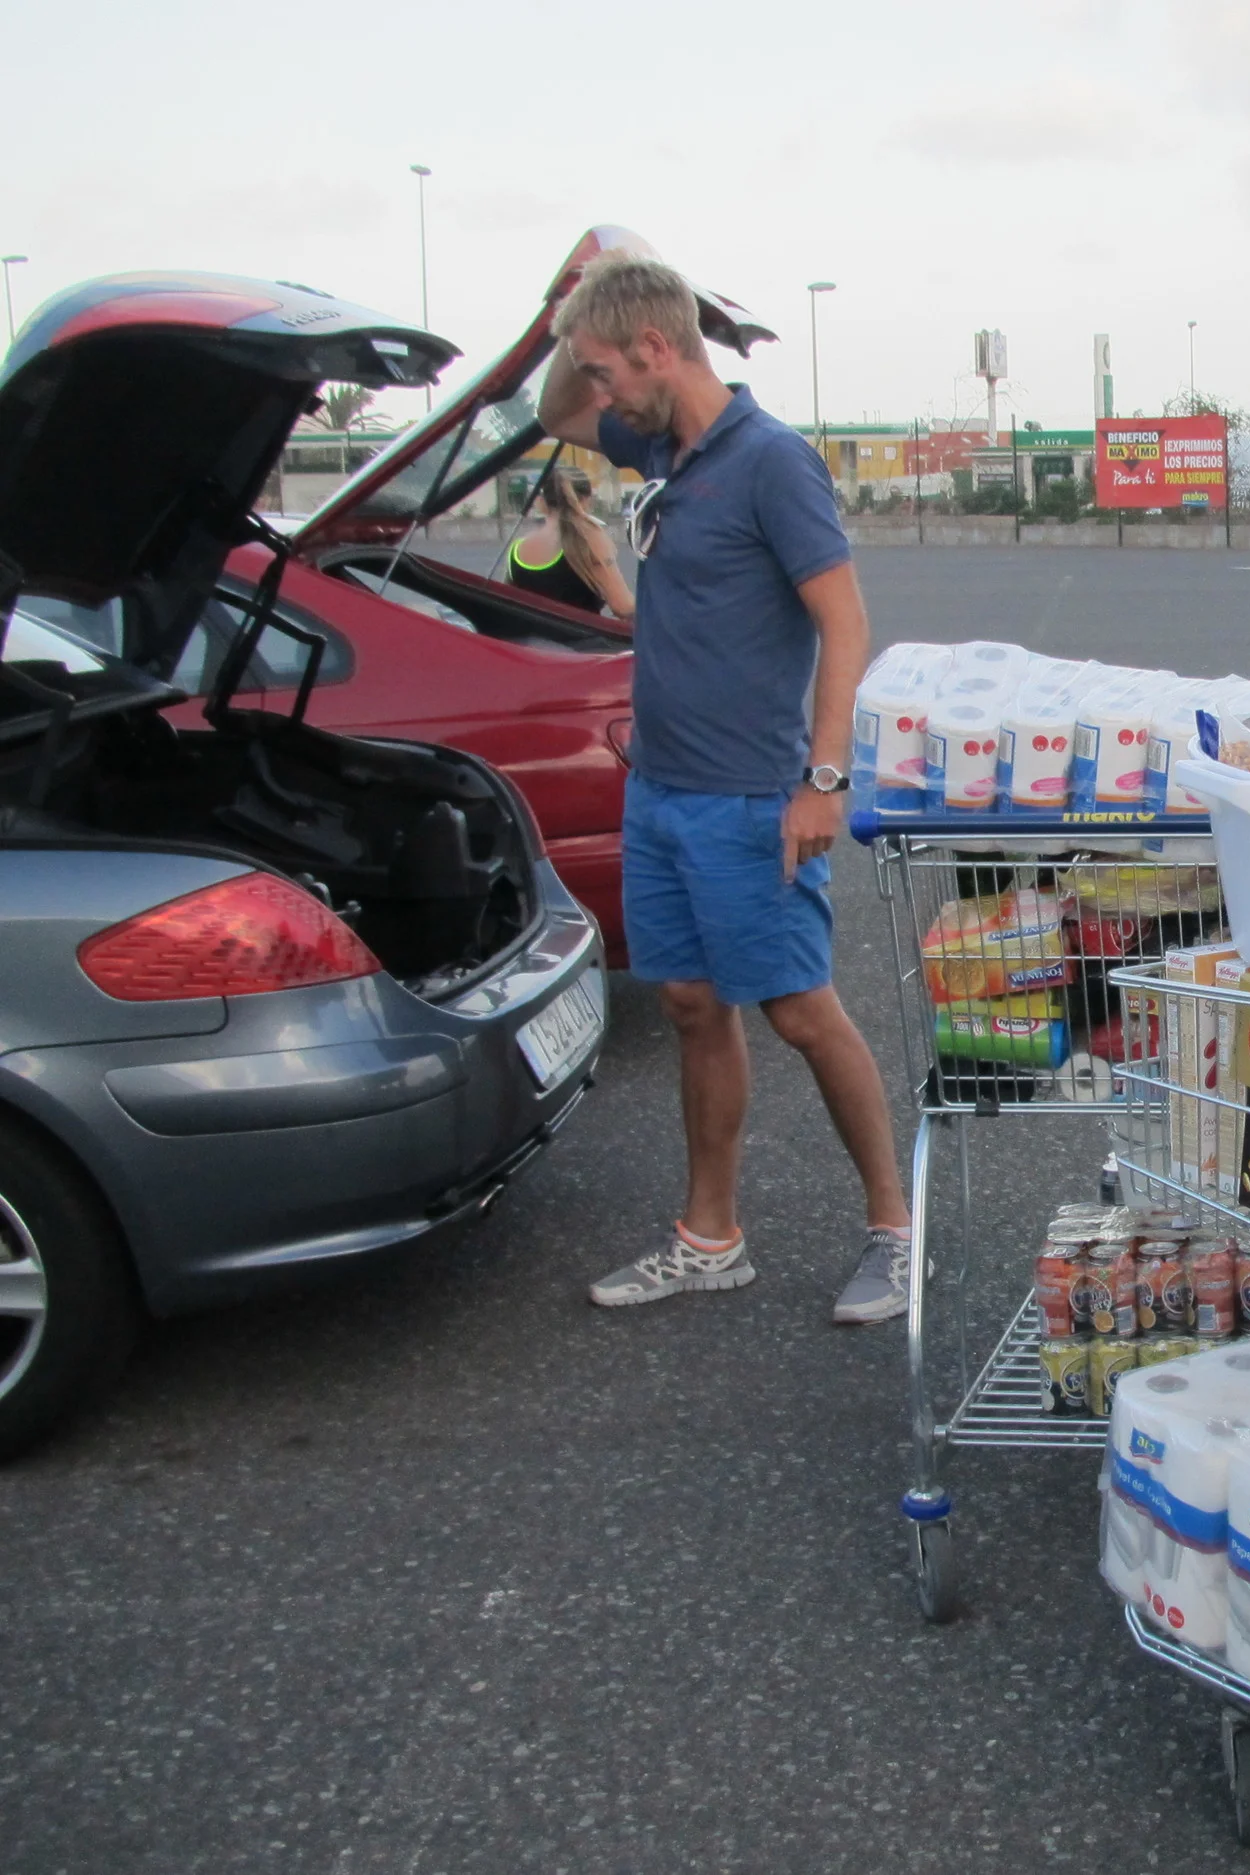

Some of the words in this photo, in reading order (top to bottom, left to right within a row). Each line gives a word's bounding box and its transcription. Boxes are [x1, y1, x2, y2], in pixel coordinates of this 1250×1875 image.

[1107, 432, 1159, 443] BENEFICIO
[1164, 456, 1181, 469] LOS
[1184, 456, 1223, 468] PRECIOS
[1113, 470, 1142, 486] Para
[1145, 468, 1156, 485] ti
[1164, 472, 1185, 484] PARA
[528, 1000, 576, 1064] 1524
[1131, 1478, 1145, 1492] de
